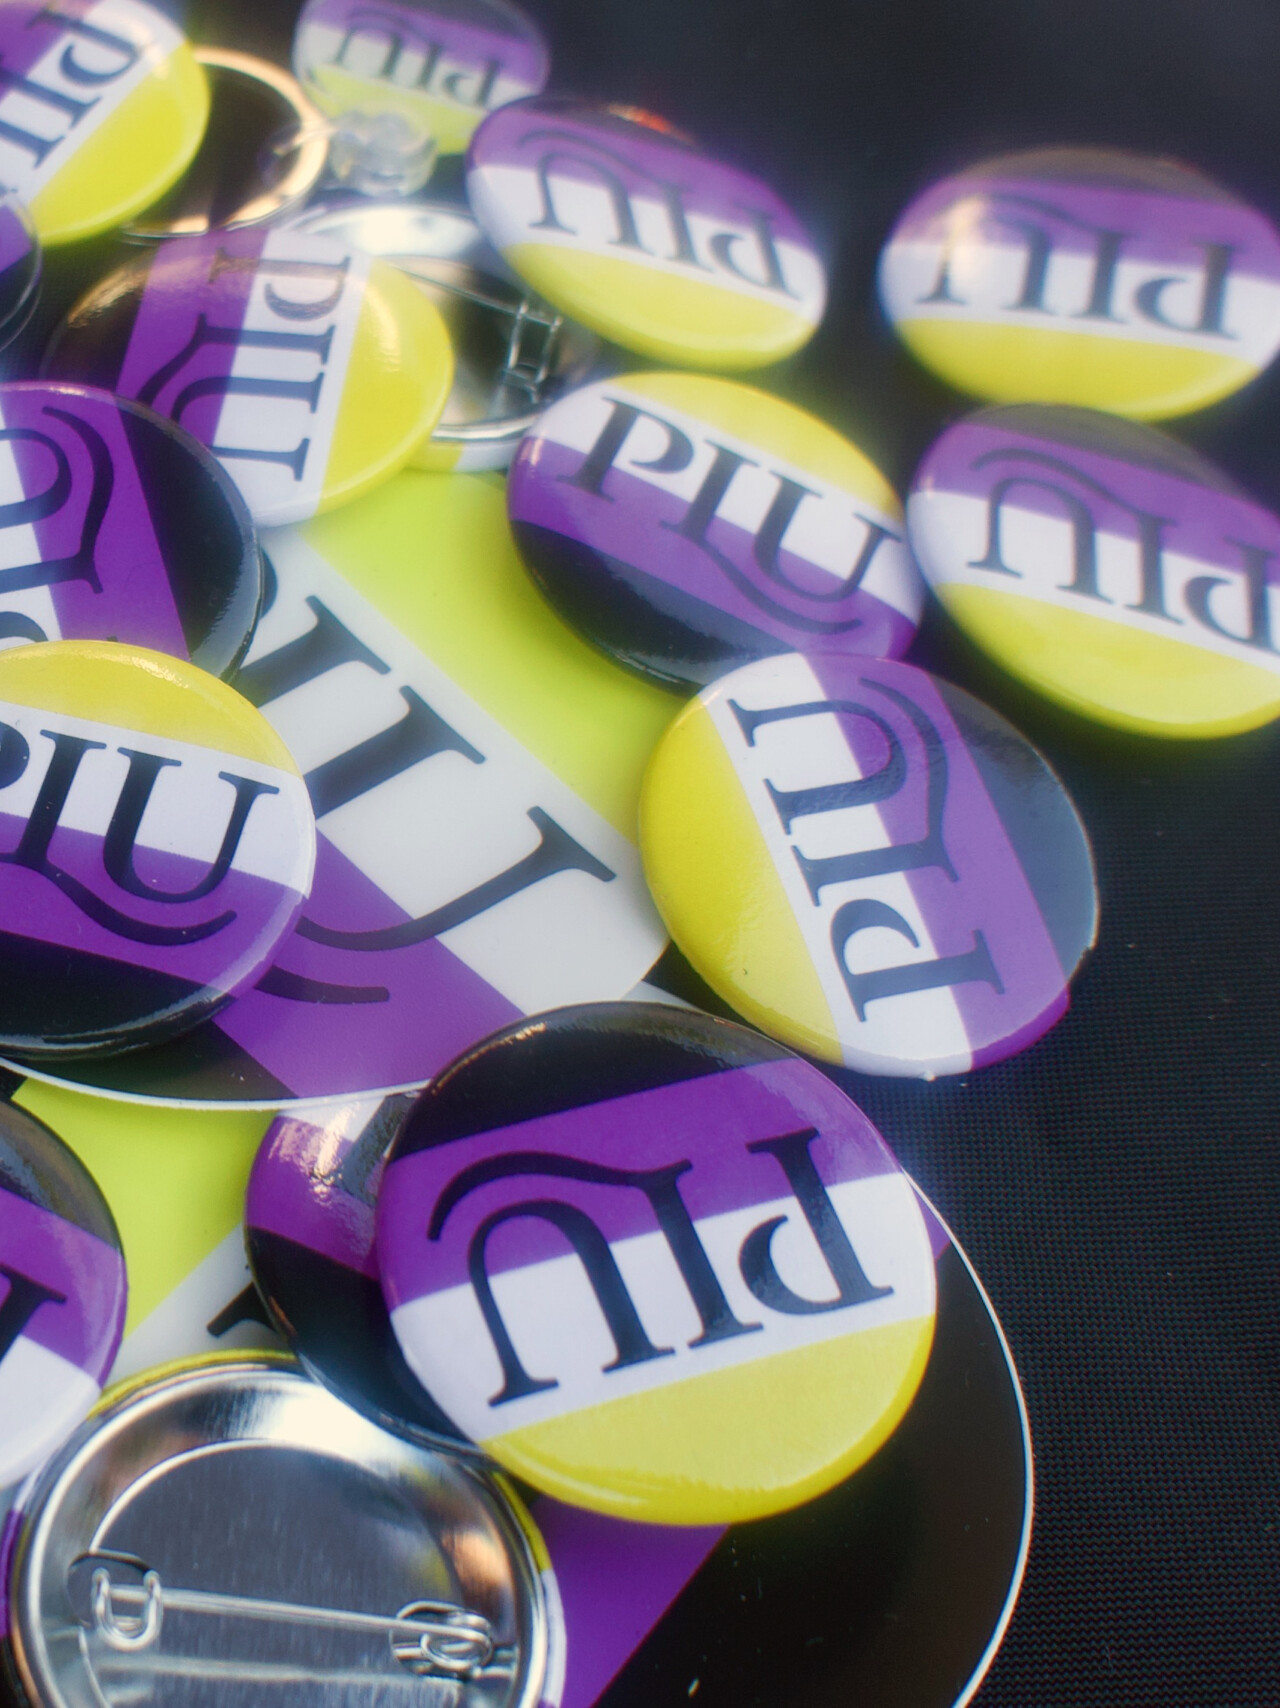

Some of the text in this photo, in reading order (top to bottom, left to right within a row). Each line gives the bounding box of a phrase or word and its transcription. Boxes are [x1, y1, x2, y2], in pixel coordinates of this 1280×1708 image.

[555, 396, 904, 635] PLU
[726, 677, 1006, 1023] PLU
[427, 1127, 895, 1407] PLU
